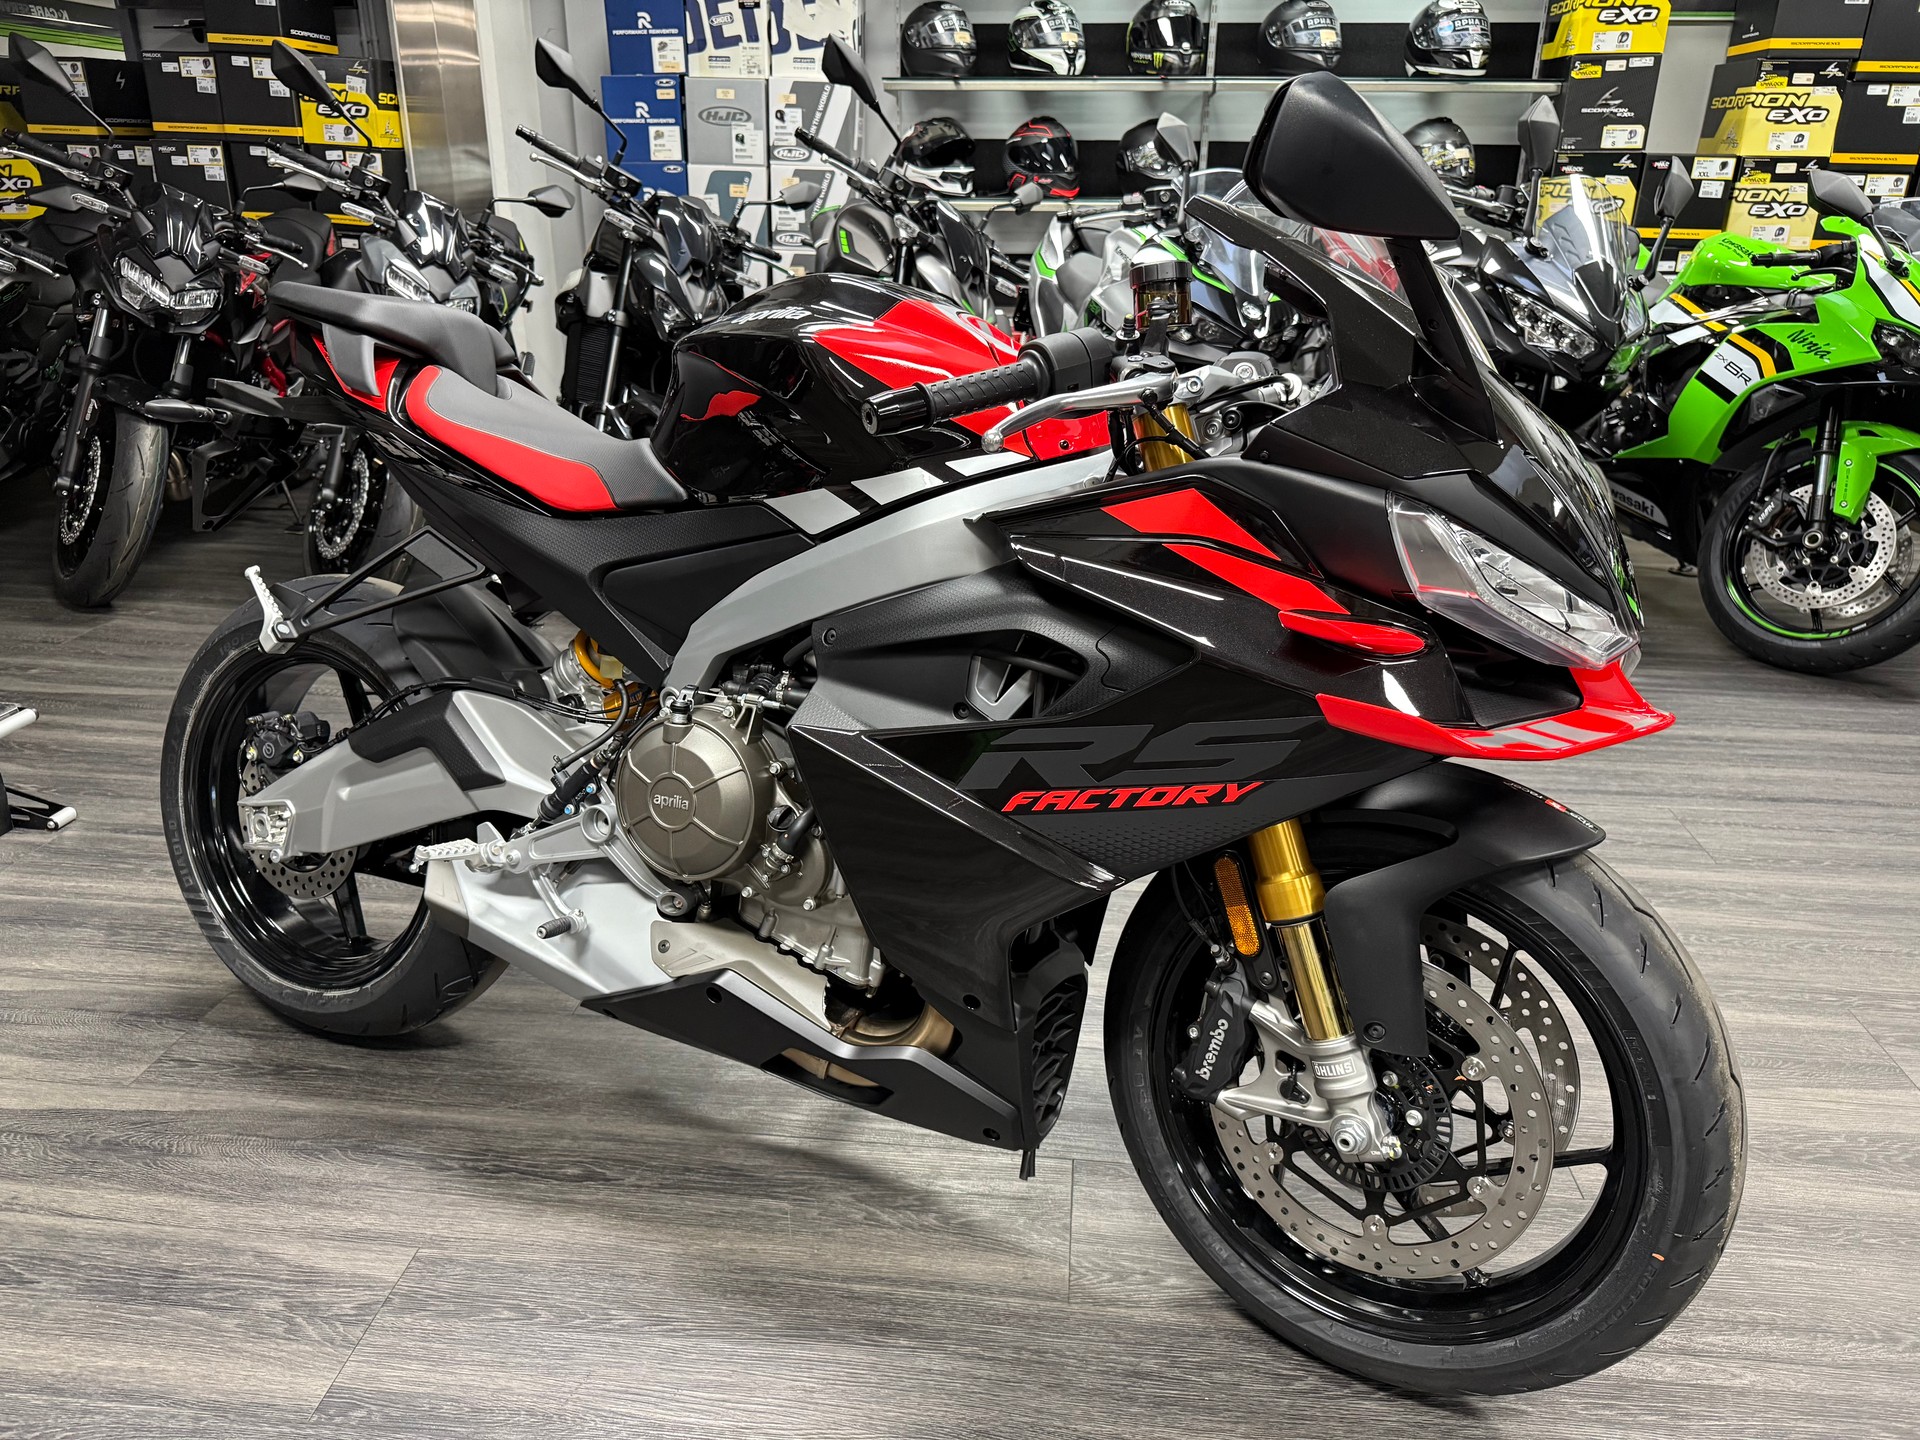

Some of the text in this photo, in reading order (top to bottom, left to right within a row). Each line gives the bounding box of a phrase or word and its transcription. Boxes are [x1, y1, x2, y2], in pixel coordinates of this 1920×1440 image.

[817, 84, 831, 111] WORLD
[1710, 93, 1809, 109] SCORPION
[705, 110, 745, 122] HJC
[1767, 108, 1828, 123] EXO
[778, 149, 805, 158] HJC
[1750, 202, 1808, 217] EXO
[1787, 329, 1832, 361] Ninja
[1611, 487, 1656, 517] wasaki
[956, 716, 1326, 790] RS
[653, 792, 690, 811] aprilia
[1001, 781, 1264, 813] FACTORY
[1195, 1018, 1229, 1081] brembo
